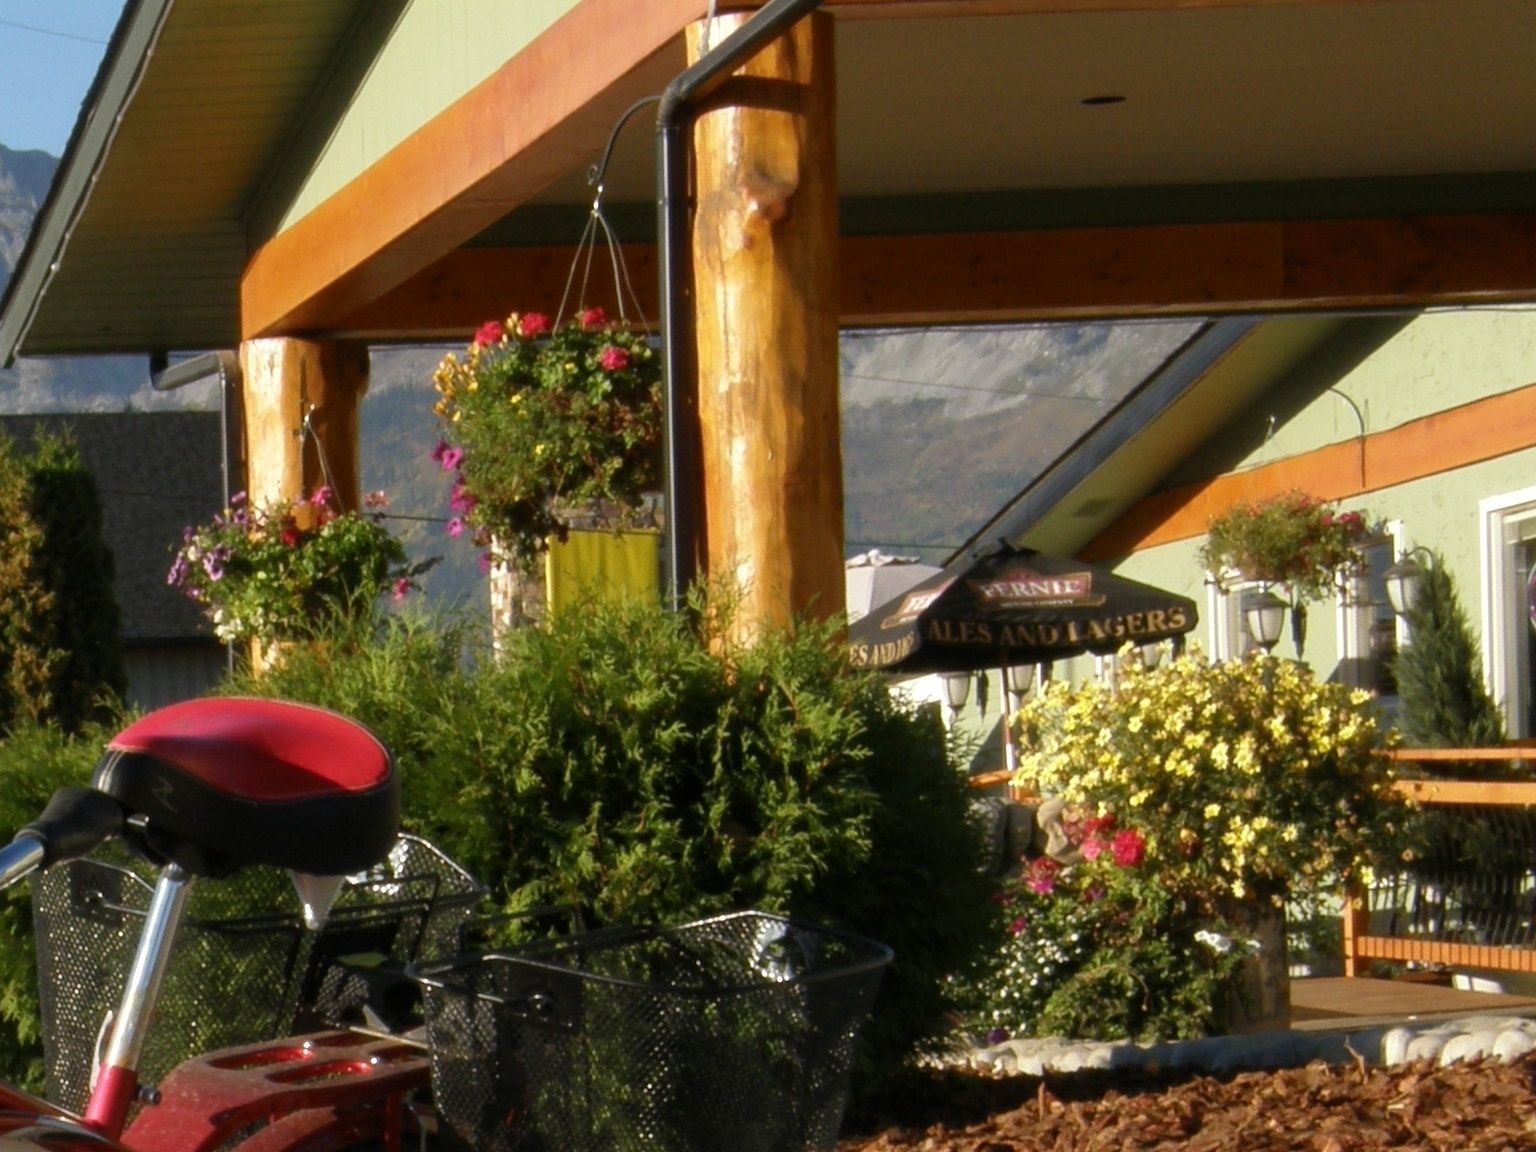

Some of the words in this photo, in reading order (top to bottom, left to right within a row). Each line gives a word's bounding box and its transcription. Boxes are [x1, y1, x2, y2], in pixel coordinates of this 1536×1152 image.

[978, 580, 1082, 599] FERNIE
[928, 619, 993, 643] ALES
[1000, 623, 1059, 646] AND
[1066, 607, 1187, 643] LAGERS
